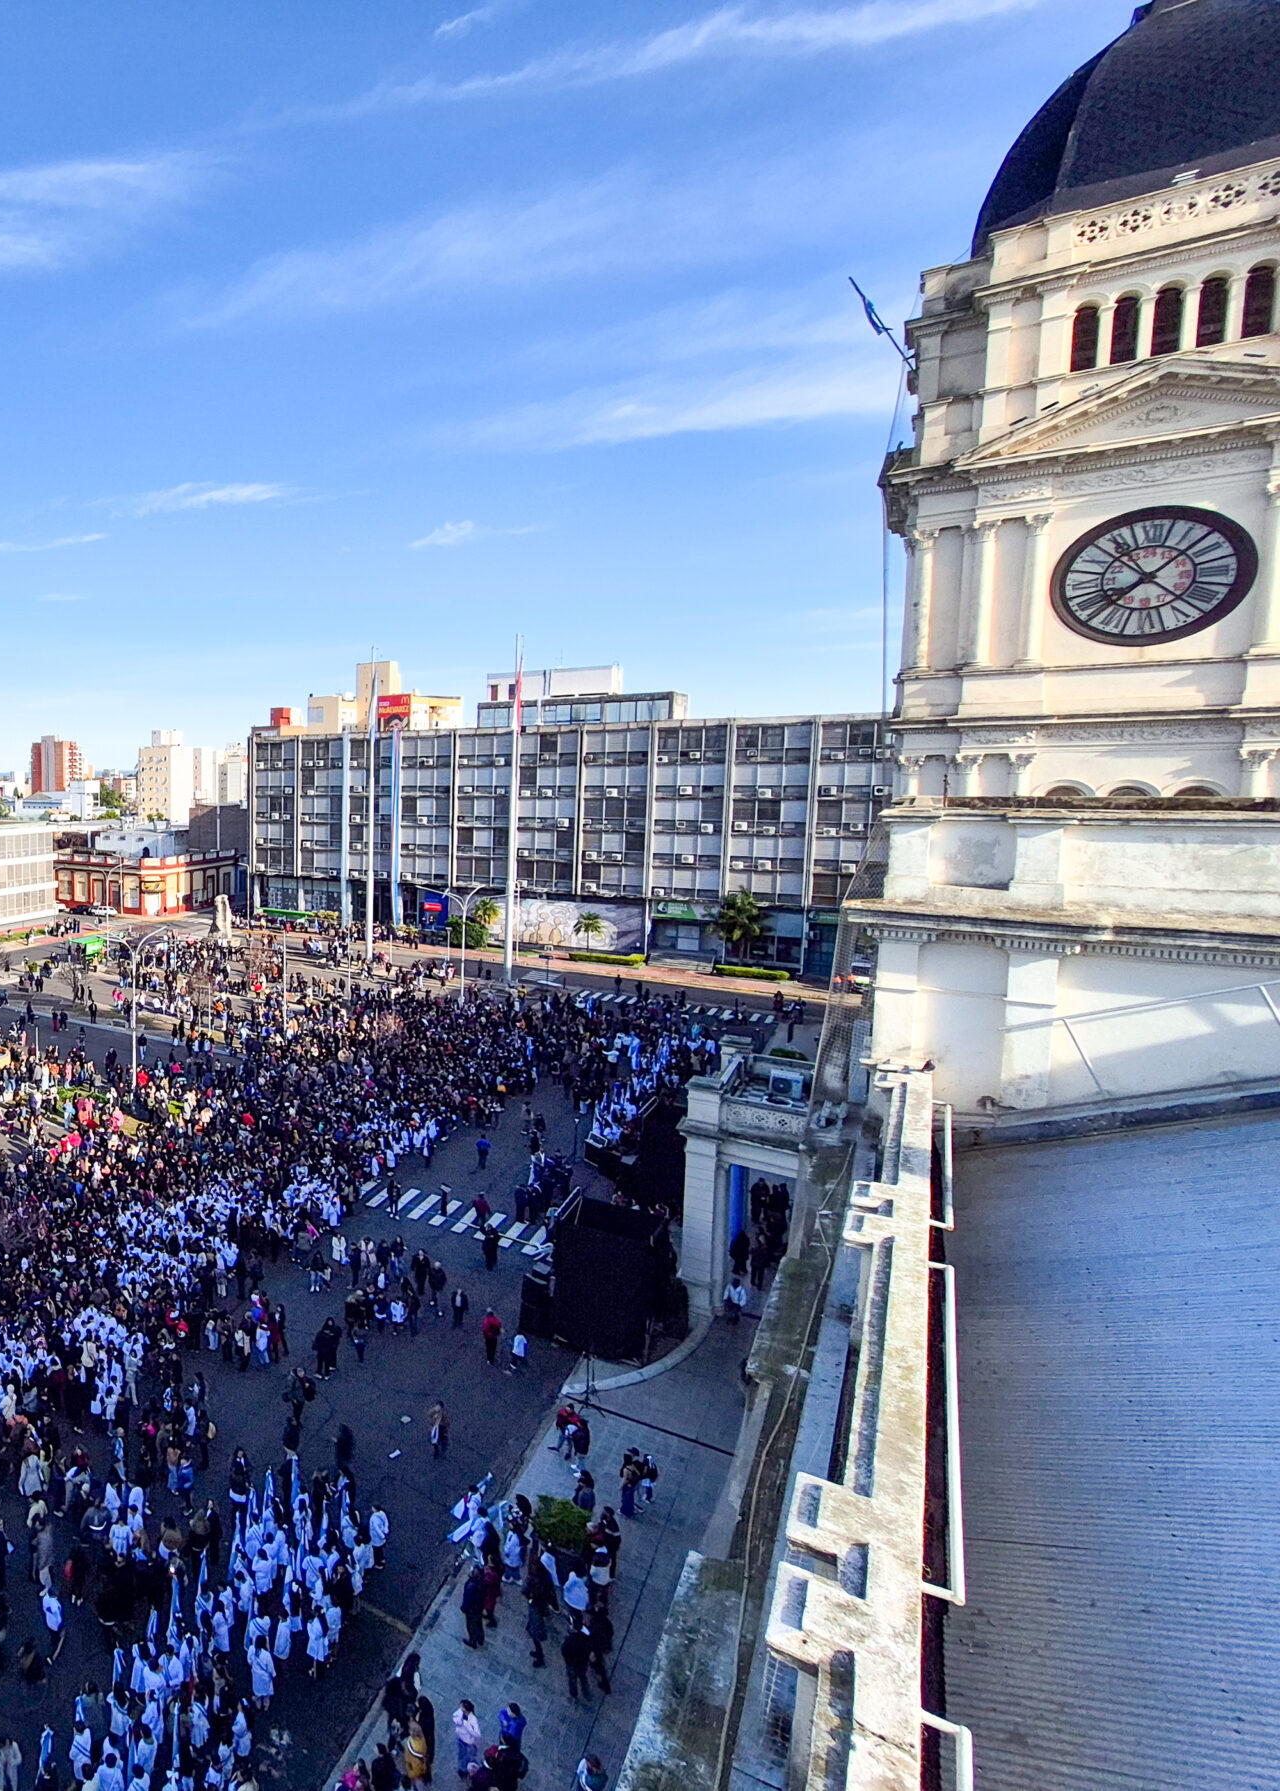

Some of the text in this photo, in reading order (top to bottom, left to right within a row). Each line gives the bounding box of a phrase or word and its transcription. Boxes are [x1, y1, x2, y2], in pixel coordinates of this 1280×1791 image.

[1141, 523, 1165, 545] XII
[1191, 541, 1223, 559] II
[1111, 565, 1125, 574] 22
[1198, 564, 1231, 578] III
